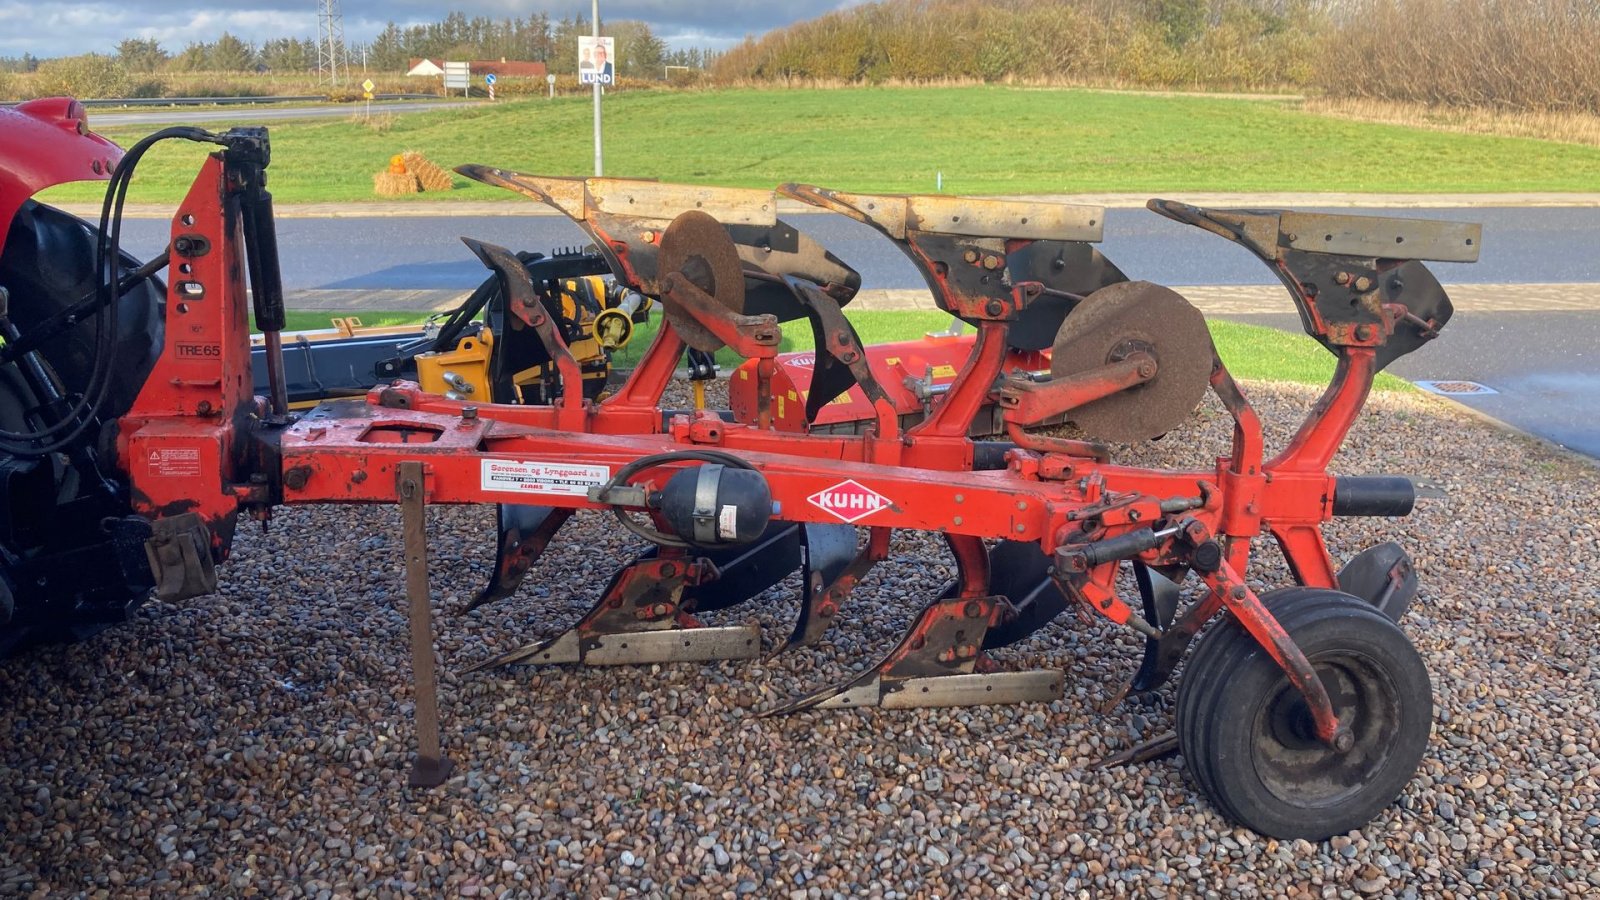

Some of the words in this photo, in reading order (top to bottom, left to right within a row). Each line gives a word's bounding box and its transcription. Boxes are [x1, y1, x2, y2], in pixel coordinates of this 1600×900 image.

[582, 73, 611, 83] LUND
[491, 464, 527, 473] Sørensen
[531, 468, 541, 476] og
[544, 467, 588, 477] Lynggaard
[820, 492, 880, 509] KUHN
